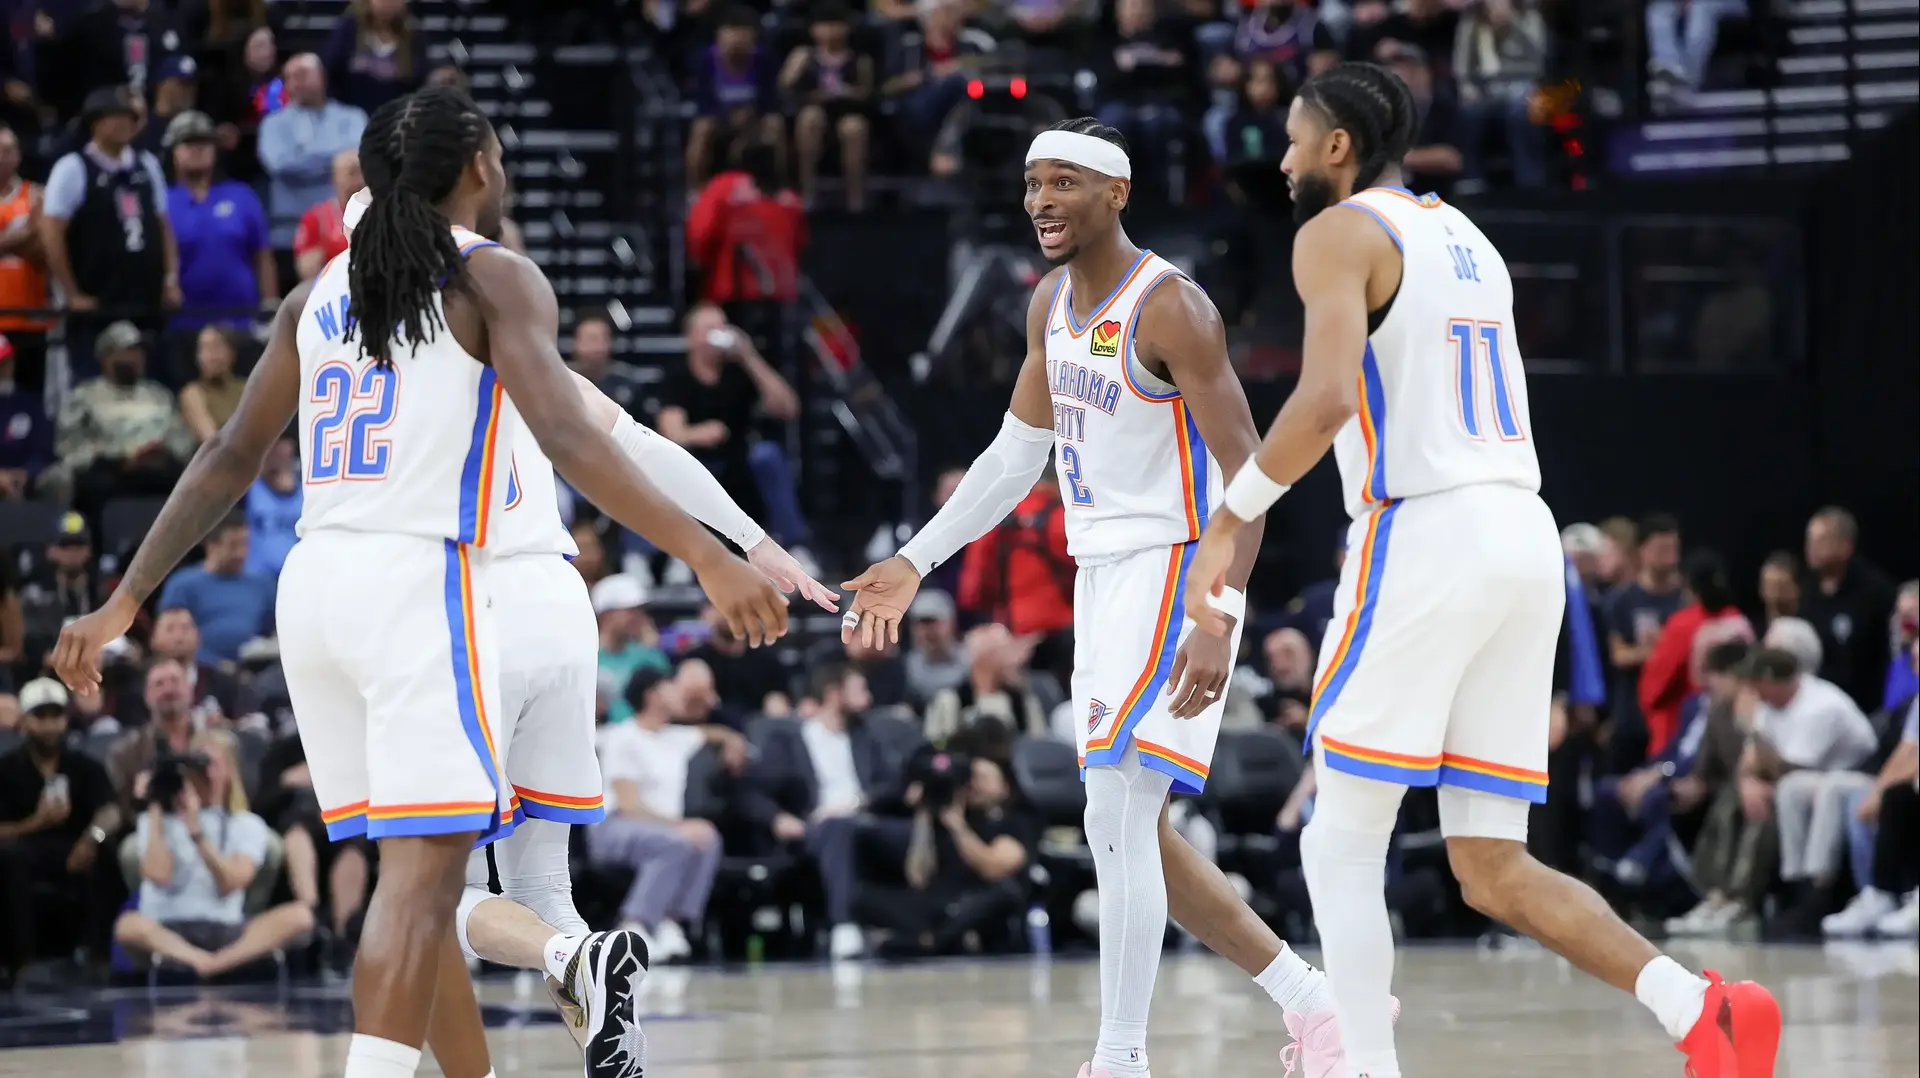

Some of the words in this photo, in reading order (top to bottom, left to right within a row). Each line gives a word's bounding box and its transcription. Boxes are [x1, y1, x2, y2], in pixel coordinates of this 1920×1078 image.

[1446, 244, 1481, 283] JOE
[1093, 342, 1116, 354] Love's
[1047, 360, 1122, 416] LAHOMA
[1447, 318, 1526, 442] 11
[306, 360, 401, 485] 22
[1062, 443, 1095, 508] 2
